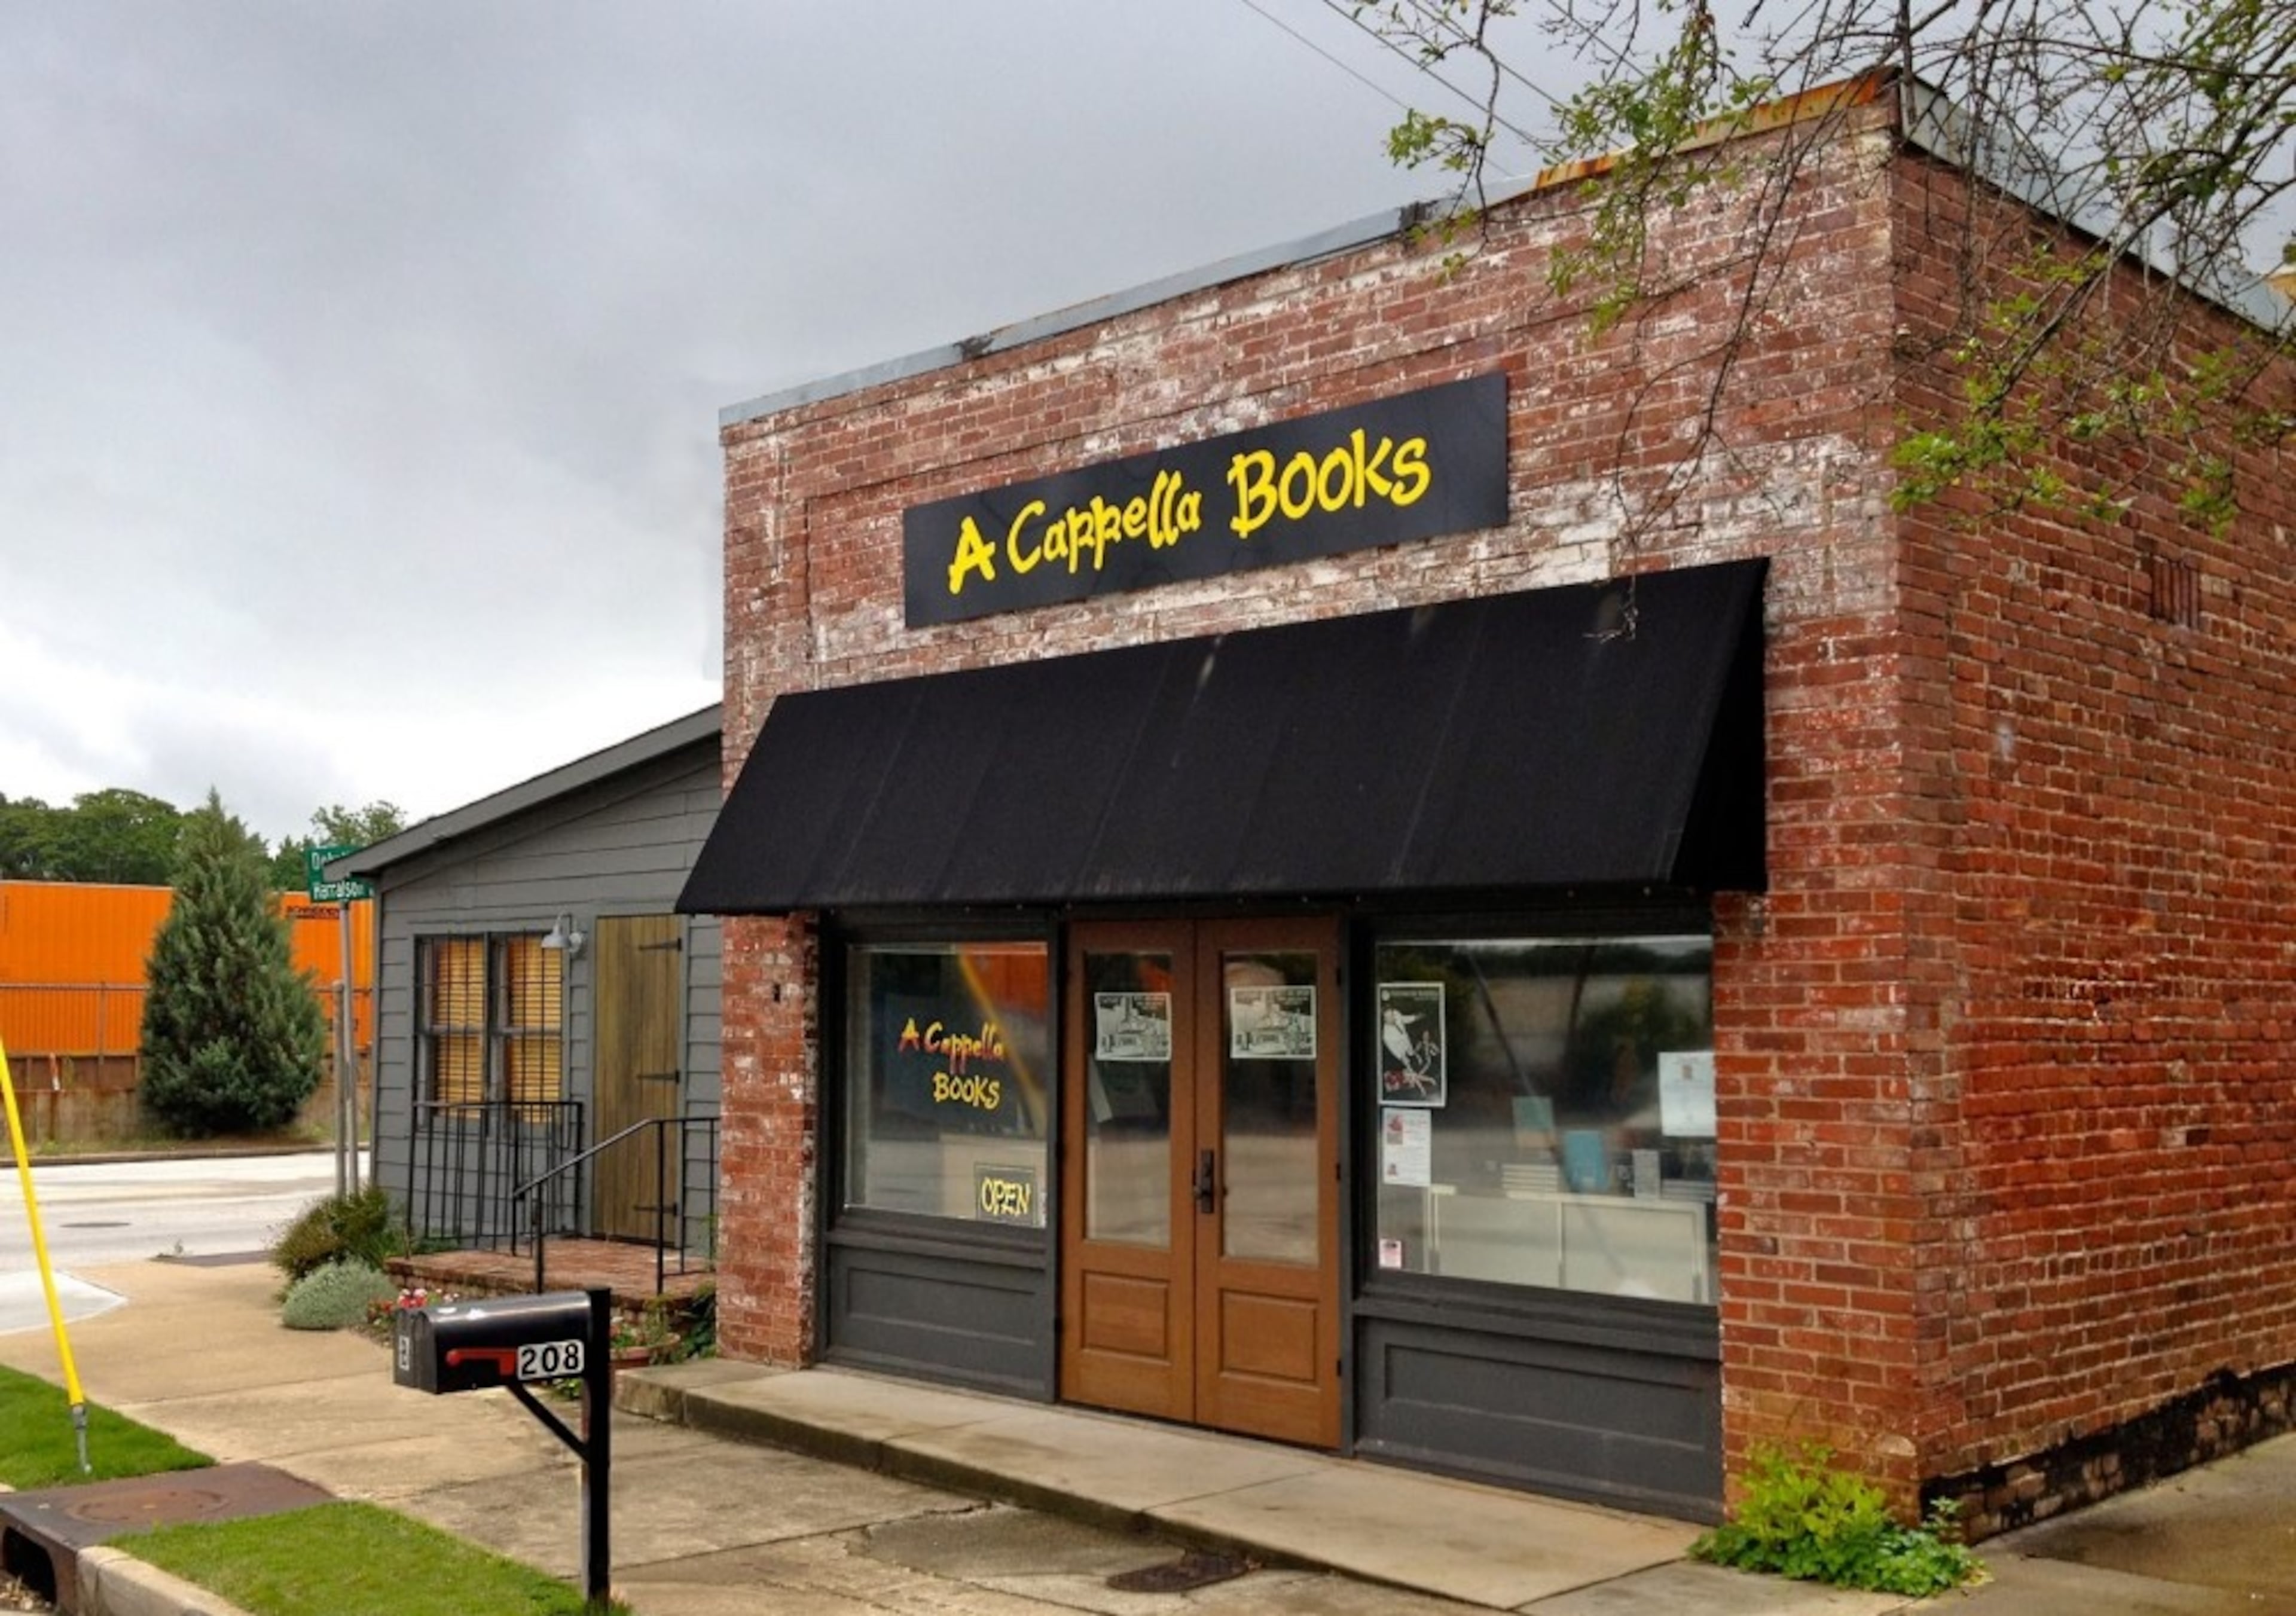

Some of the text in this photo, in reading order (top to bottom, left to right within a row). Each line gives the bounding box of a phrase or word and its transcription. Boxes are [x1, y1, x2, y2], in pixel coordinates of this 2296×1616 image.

[947, 516, 997, 594] A
[1006, 471, 1202, 575] Cappella
[898, 1017, 1004, 1074] A Cappella
[981, 1177, 1031, 1216] OPEN
[521, 1343, 579, 1376] 208
